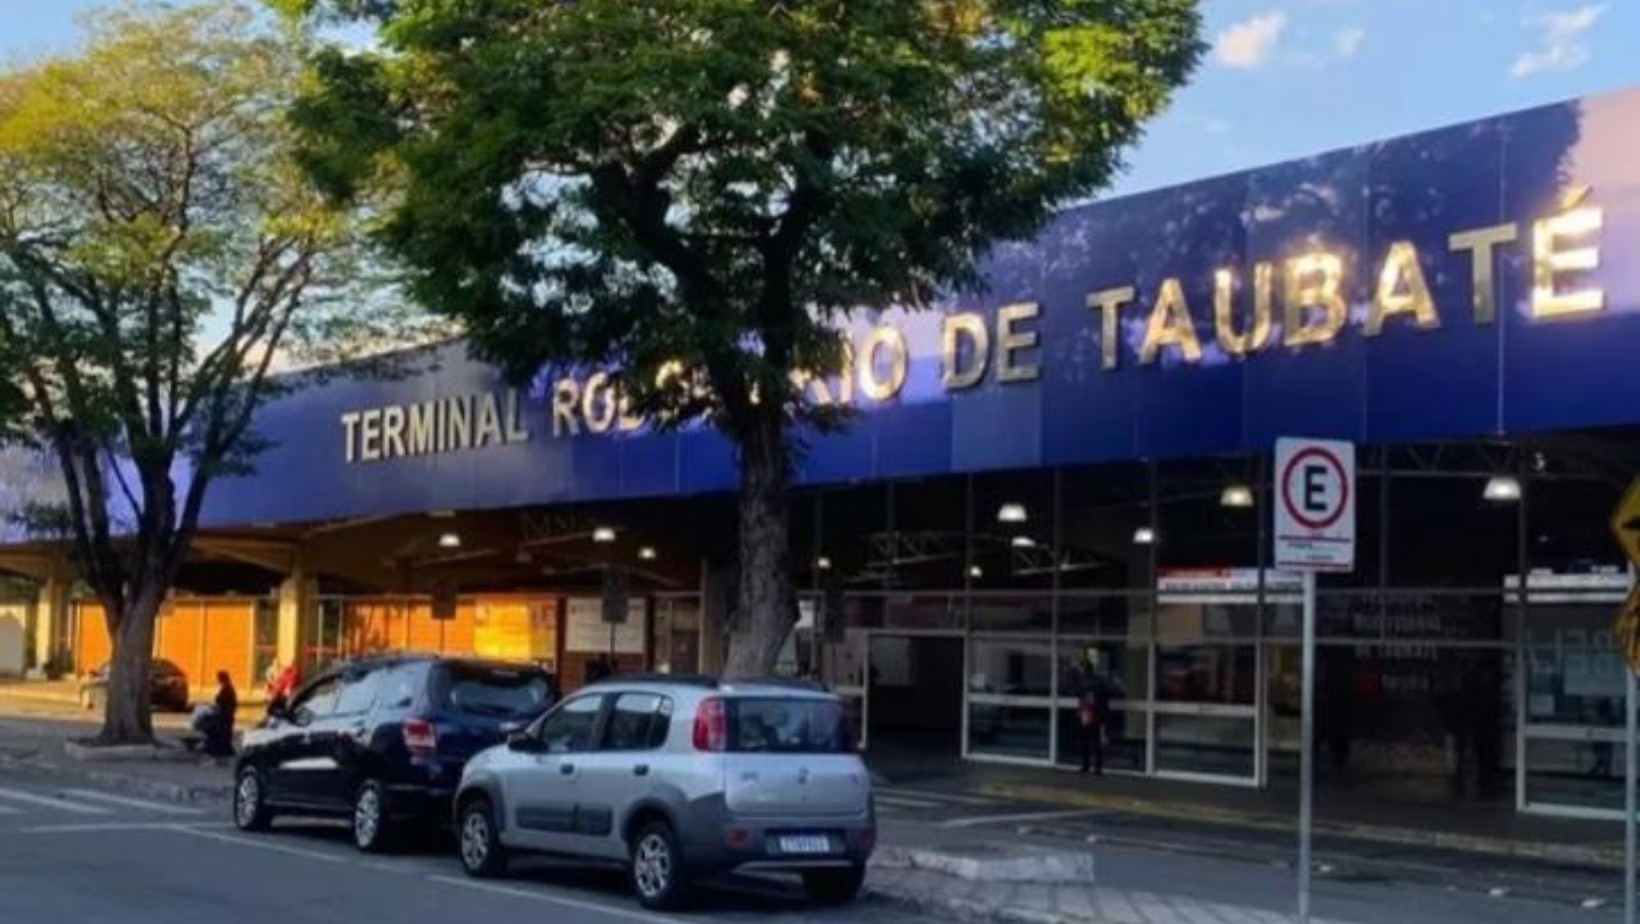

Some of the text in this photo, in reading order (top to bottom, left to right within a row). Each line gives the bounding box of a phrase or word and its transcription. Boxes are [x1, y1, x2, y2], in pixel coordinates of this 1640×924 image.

[341, 390, 528, 463] TERMINAL
[943, 302, 1041, 389] DE
[1085, 184, 1604, 369] TAUBATÉ
[1304, 465, 1328, 511] E
